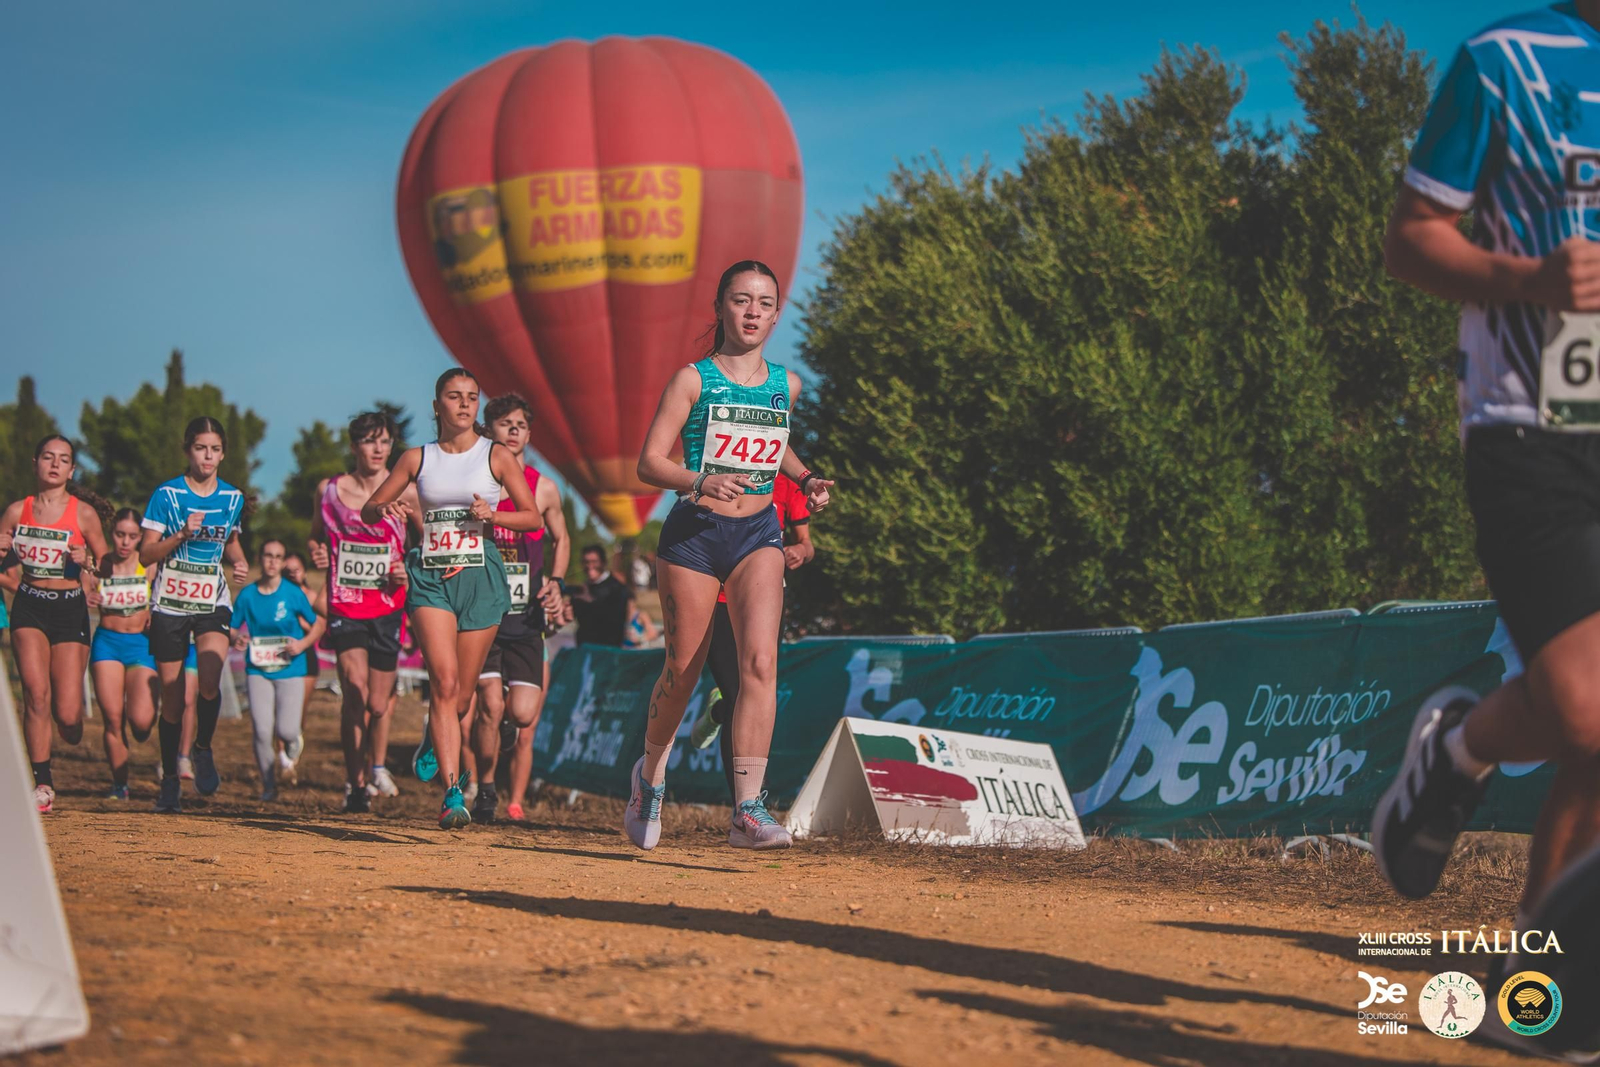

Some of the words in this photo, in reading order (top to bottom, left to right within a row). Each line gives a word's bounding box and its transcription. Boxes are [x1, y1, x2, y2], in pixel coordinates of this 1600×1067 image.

[529, 169, 683, 208] FUERZAS
[529, 206, 685, 249] ARMADAS
[1562, 338, 1600, 388] 6
[714, 433, 782, 464] 7422
[191, 526, 226, 540] AR
[429, 530, 479, 551] 5475
[19, 544, 63, 564] 5457
[343, 560, 386, 576] 6020
[28, 588, 59, 600] PRO
[106, 591, 146, 605] 7456
[165, 578, 213, 599] 5520
[513, 583, 525, 599] 4
[935, 685, 1056, 725] Diputación
[1244, 680, 1391, 736] Diputación
[965, 748, 988, 761] CROSS
[989, 750, 1043, 768] INTERNACIONAL
[1216, 734, 1367, 805] Sevilla
[976, 767, 1071, 821] ITÁLICA
